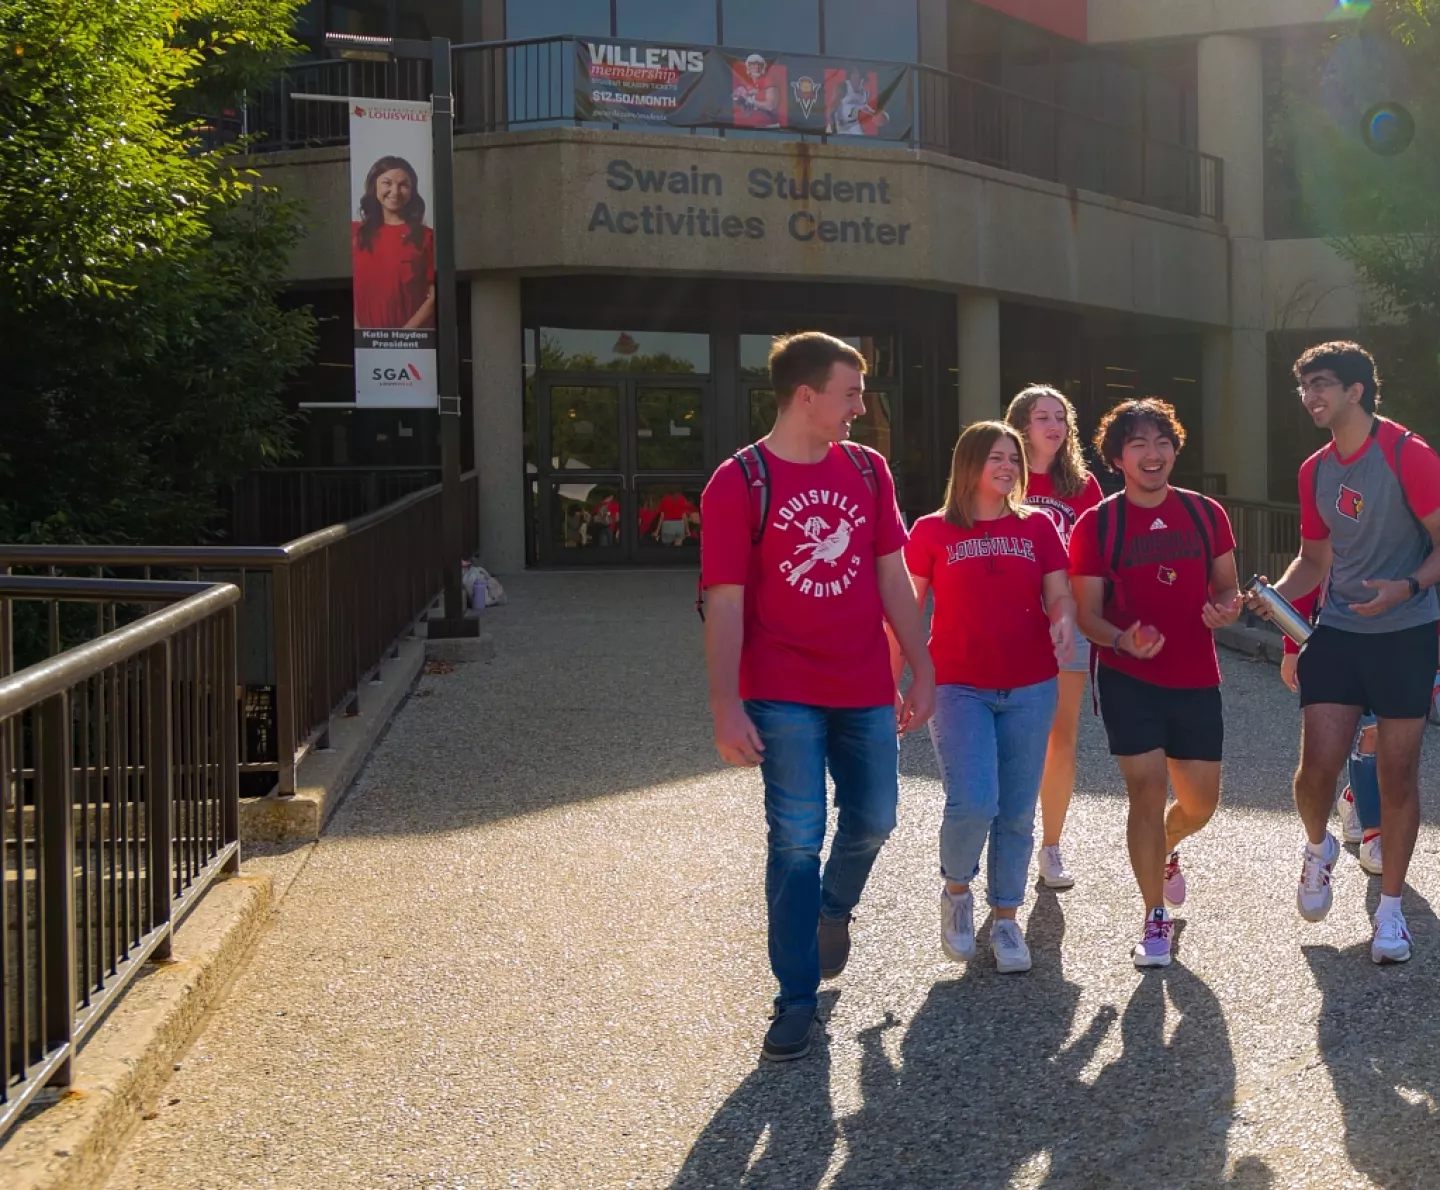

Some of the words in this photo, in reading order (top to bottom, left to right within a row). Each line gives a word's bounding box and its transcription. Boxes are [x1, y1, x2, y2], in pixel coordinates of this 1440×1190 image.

[588, 43, 703, 73] VILLE'NS
[591, 64, 676, 83] membership
[592, 90, 676, 107] $12.50/MONTH
[369, 111, 428, 122] LOUISVILLE
[606, 159, 722, 196] Swain
[748, 168, 890, 205] Student
[588, 203, 765, 240] Activities
[788, 211, 911, 246] Center
[362, 331, 389, 339] Katie
[392, 331, 428, 340] Hayden
[372, 340, 419, 349] President
[372, 367, 410, 381] SGA
[773, 489, 866, 531] LOUISVILLE
[946, 536, 1036, 565] LOUISVILLE
[779, 555, 861, 598] CARDINALS
